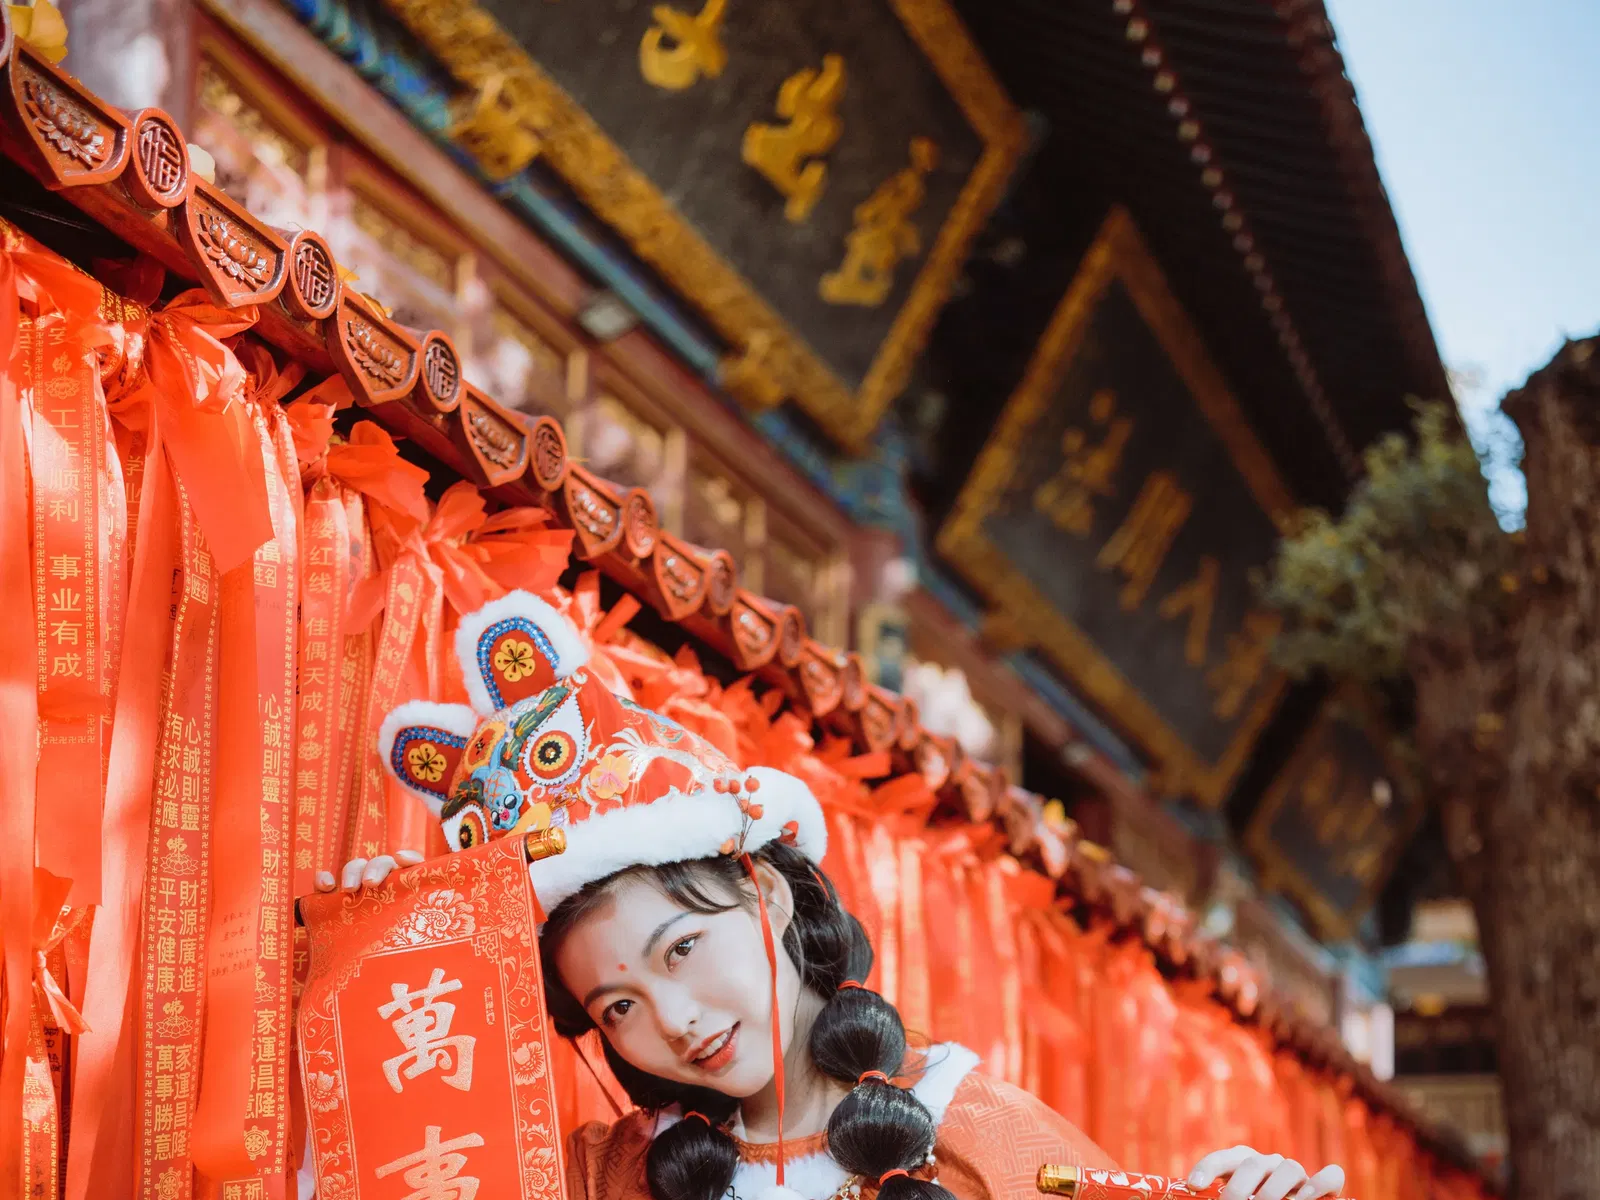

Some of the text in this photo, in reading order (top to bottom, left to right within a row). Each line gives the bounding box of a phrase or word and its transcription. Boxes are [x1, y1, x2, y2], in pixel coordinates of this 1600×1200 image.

[48, 408, 81, 523] 工作顺利
[49, 553, 82, 678] 事业有成
[192, 576, 208, 602] 姓名
[302, 617, 329, 712] 佳偶天成
[161, 712, 184, 829] 有求必應
[180, 717, 201, 831] 心誠則靈
[156, 877, 177, 994] 平安健康
[178, 880, 199, 993] 財源廣進
[255, 693, 282, 1119] 心誠則靈 財源廣進 家運昌隆
[31, 1121, 50, 1134] 姓名
[154, 1044, 176, 1161] 萬事勝意
[170, 1044, 193, 1159] 家運昌隆
